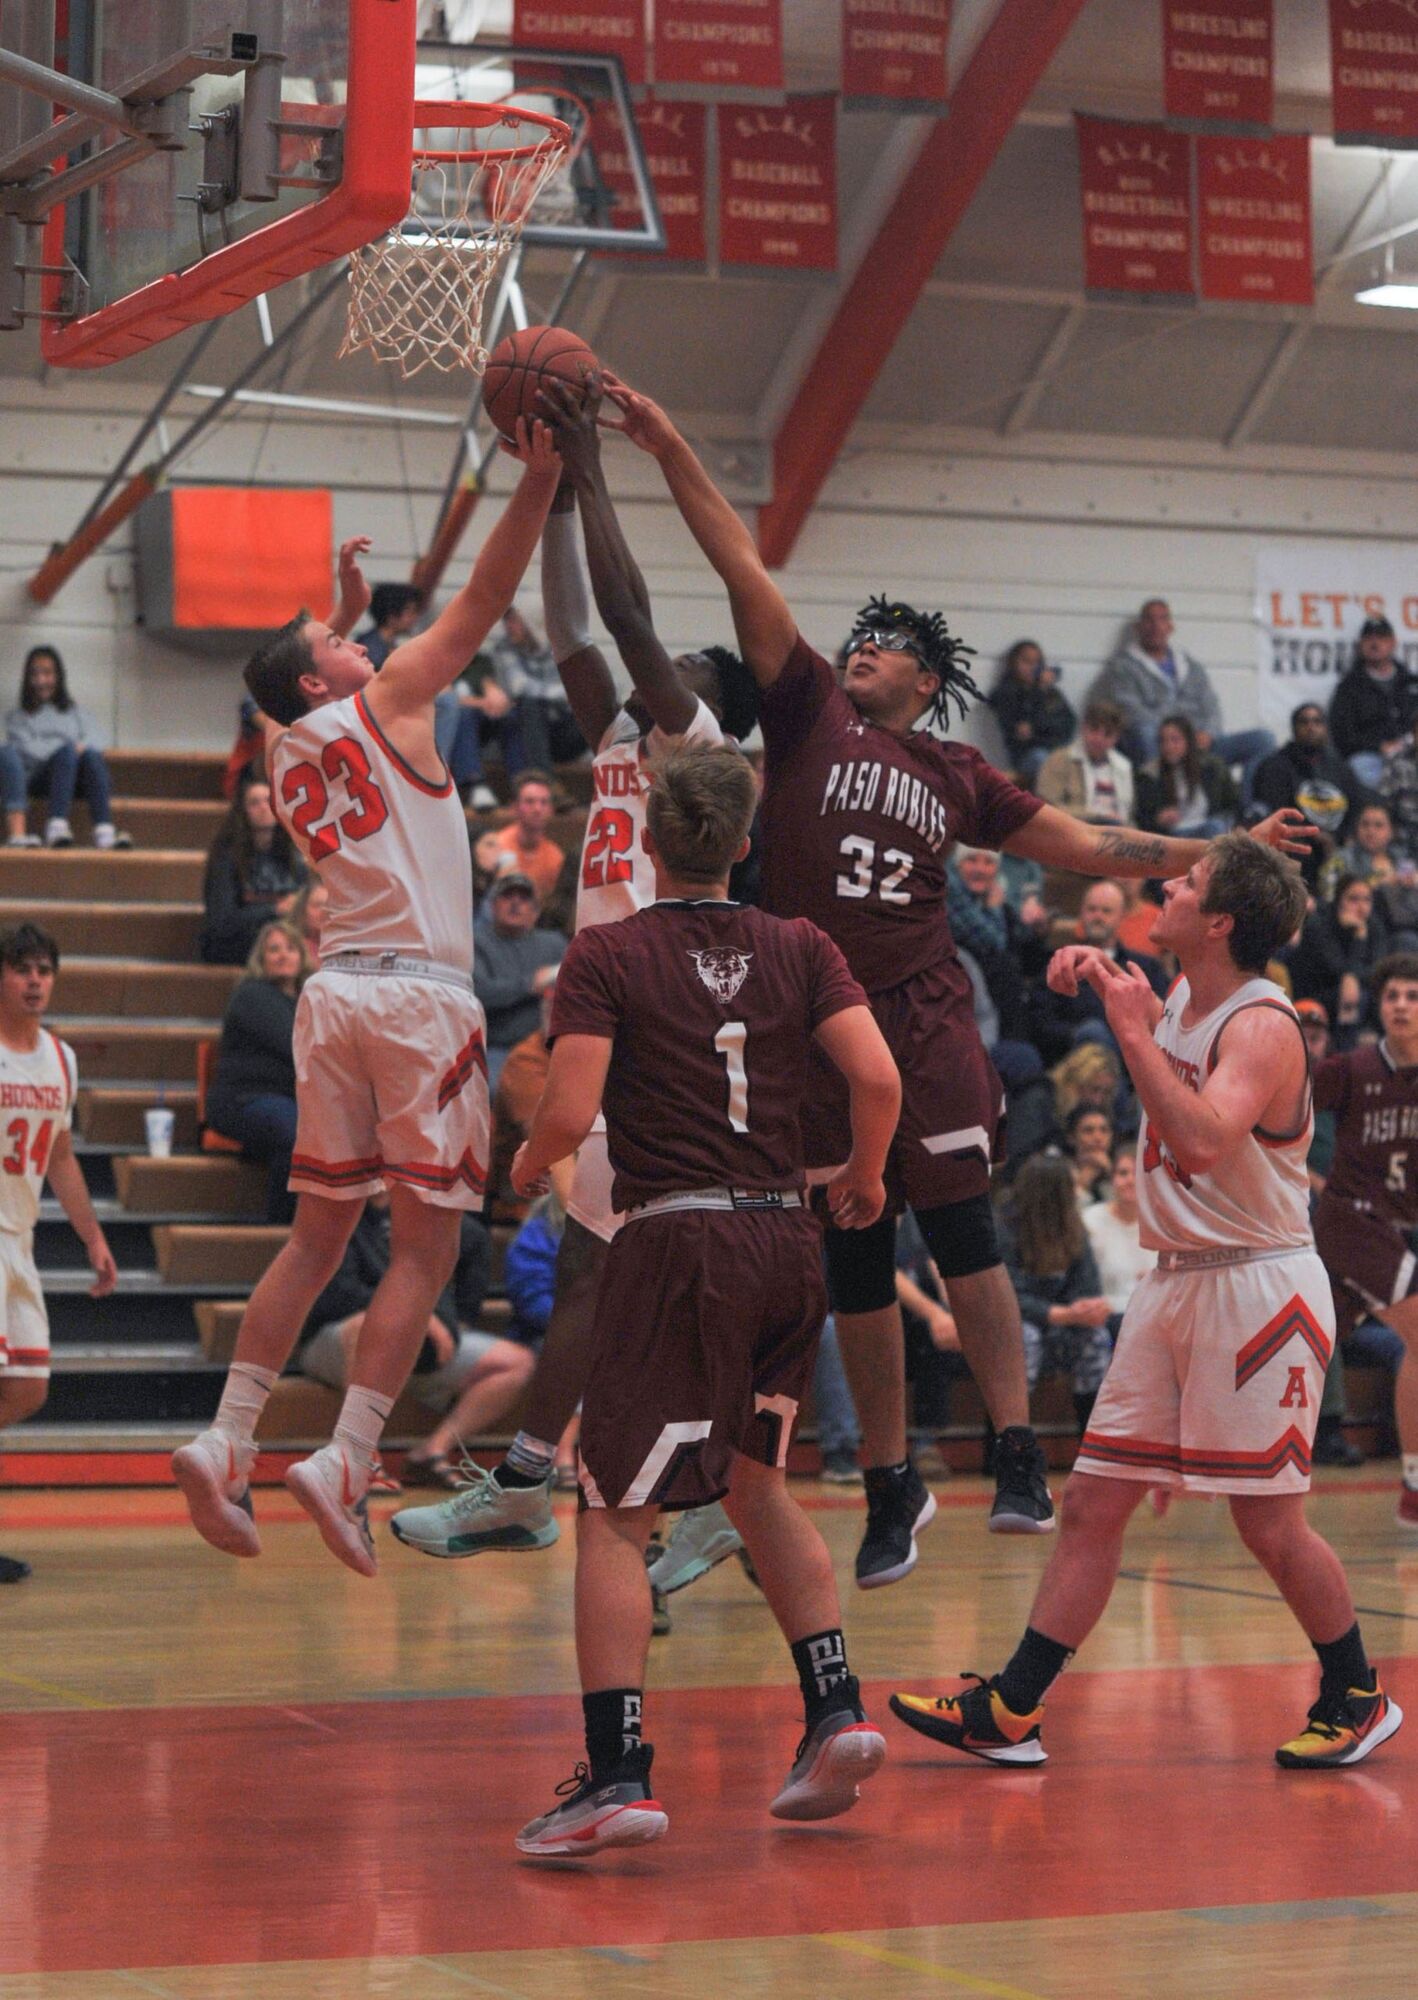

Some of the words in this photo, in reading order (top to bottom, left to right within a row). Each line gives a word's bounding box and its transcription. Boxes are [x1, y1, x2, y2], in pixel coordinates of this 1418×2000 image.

[520, 12, 636, 38] CHAMPIONS
[662, 20, 773, 45] CHAMPIONS
[725, 198, 832, 225] CHAMPIONS
[1270, 591, 1385, 630] LET'S
[281, 735, 389, 864] 23
[591, 762, 641, 802] NDS
[820, 761, 882, 816] PASO
[881, 766, 946, 853] ROBLES
[582, 807, 634, 890] 22
[836, 834, 915, 906] 32
[713, 1022, 751, 1133] 1
[3, 1117, 54, 1176] 34
[1386, 1151, 1408, 1191] 5
[1279, 1366, 1309, 1408] A
